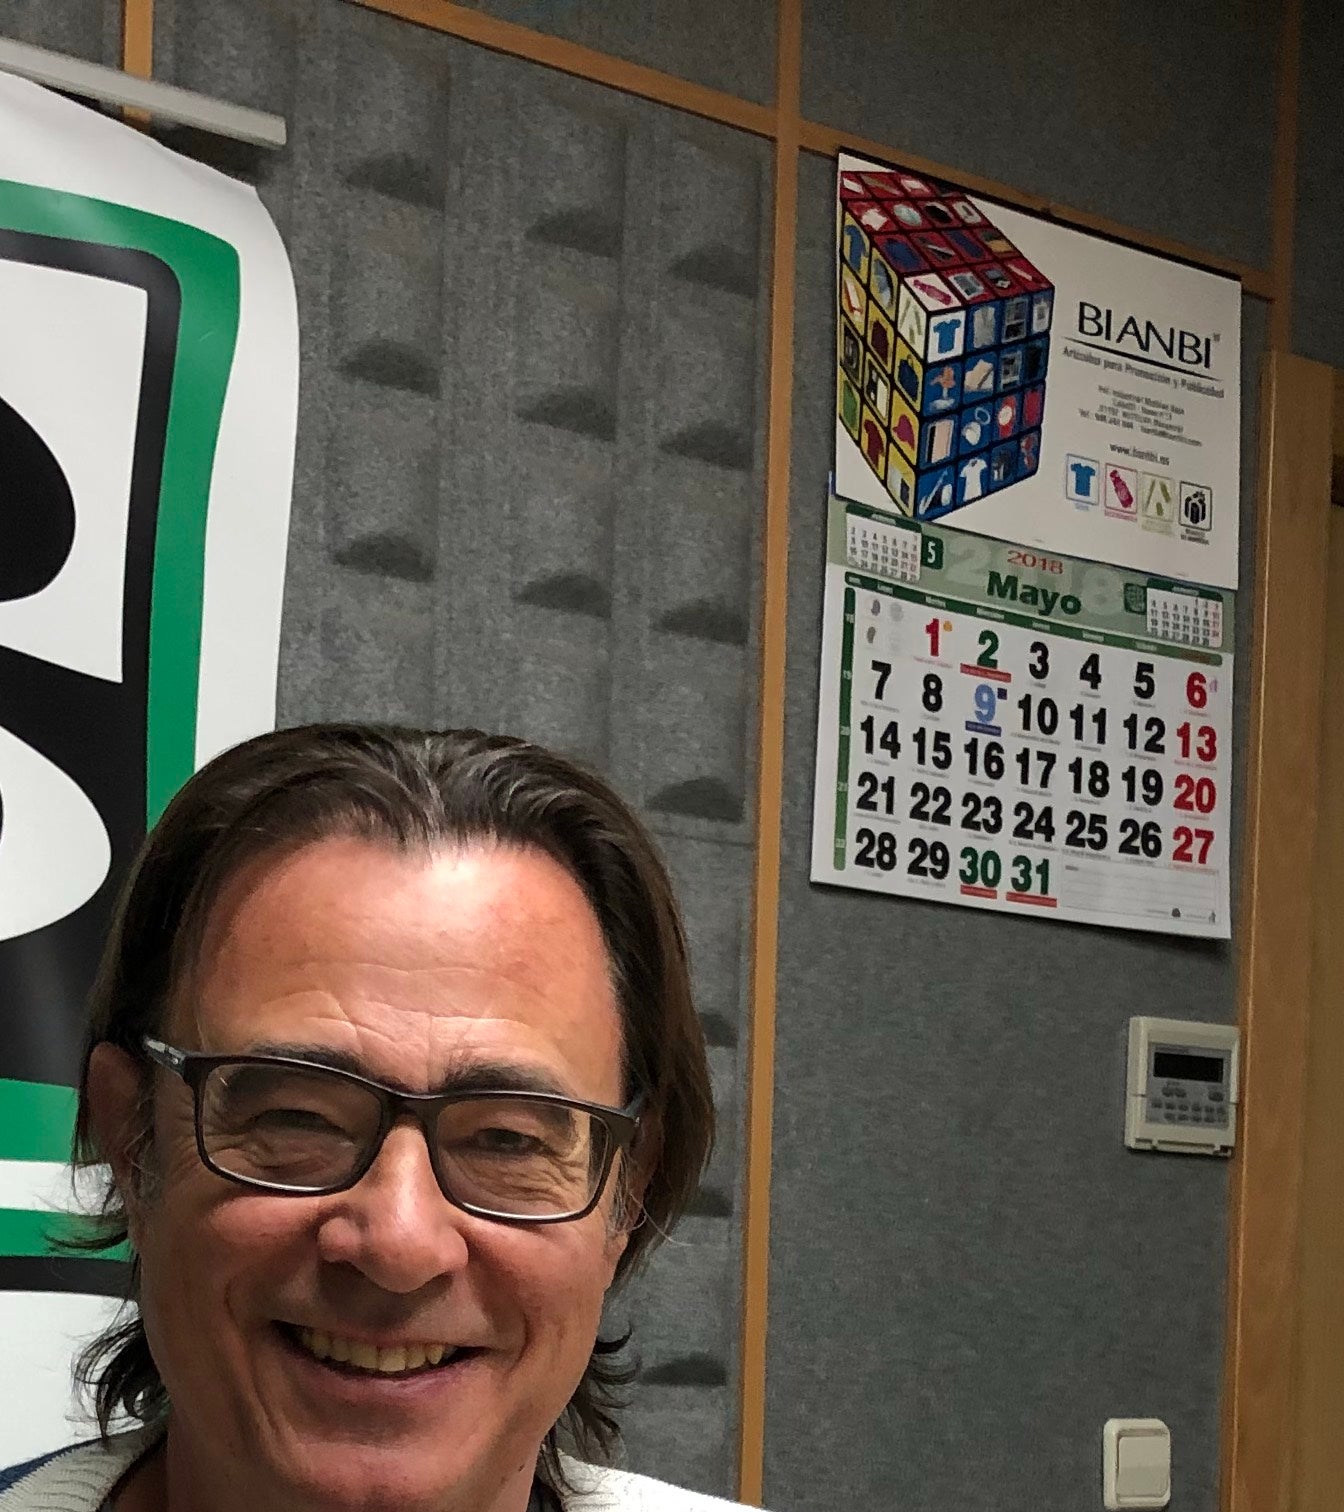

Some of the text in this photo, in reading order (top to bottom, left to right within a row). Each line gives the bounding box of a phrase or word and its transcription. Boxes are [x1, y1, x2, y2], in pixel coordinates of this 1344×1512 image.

[986, 570, 1082, 617] Mayo
[1007, 549, 1064, 575] 2018
[925, 618, 940, 657] 1
[976, 630, 999, 669] 2
[1028, 641, 1049, 680] 3
[1079, 653, 1102, 690] 4
[1133, 661, 1155, 699] 5
[1186, 671, 1207, 709] 6
[871, 659, 892, 700] 7
[922, 673, 943, 713] 8
[974, 683, 997, 723] 9
[1018, 693, 1058, 736] 10
[1069, 703, 1106, 745] 11
[1123, 712, 1165, 754] 12
[1176, 721, 1218, 762] 13
[860, 715, 1217, 814] 14 15 16 17 18 19 20
[854, 827, 1050, 896] 28 29 30 31
[856, 771, 1215, 865] 21 22 23 24 25 26 27
